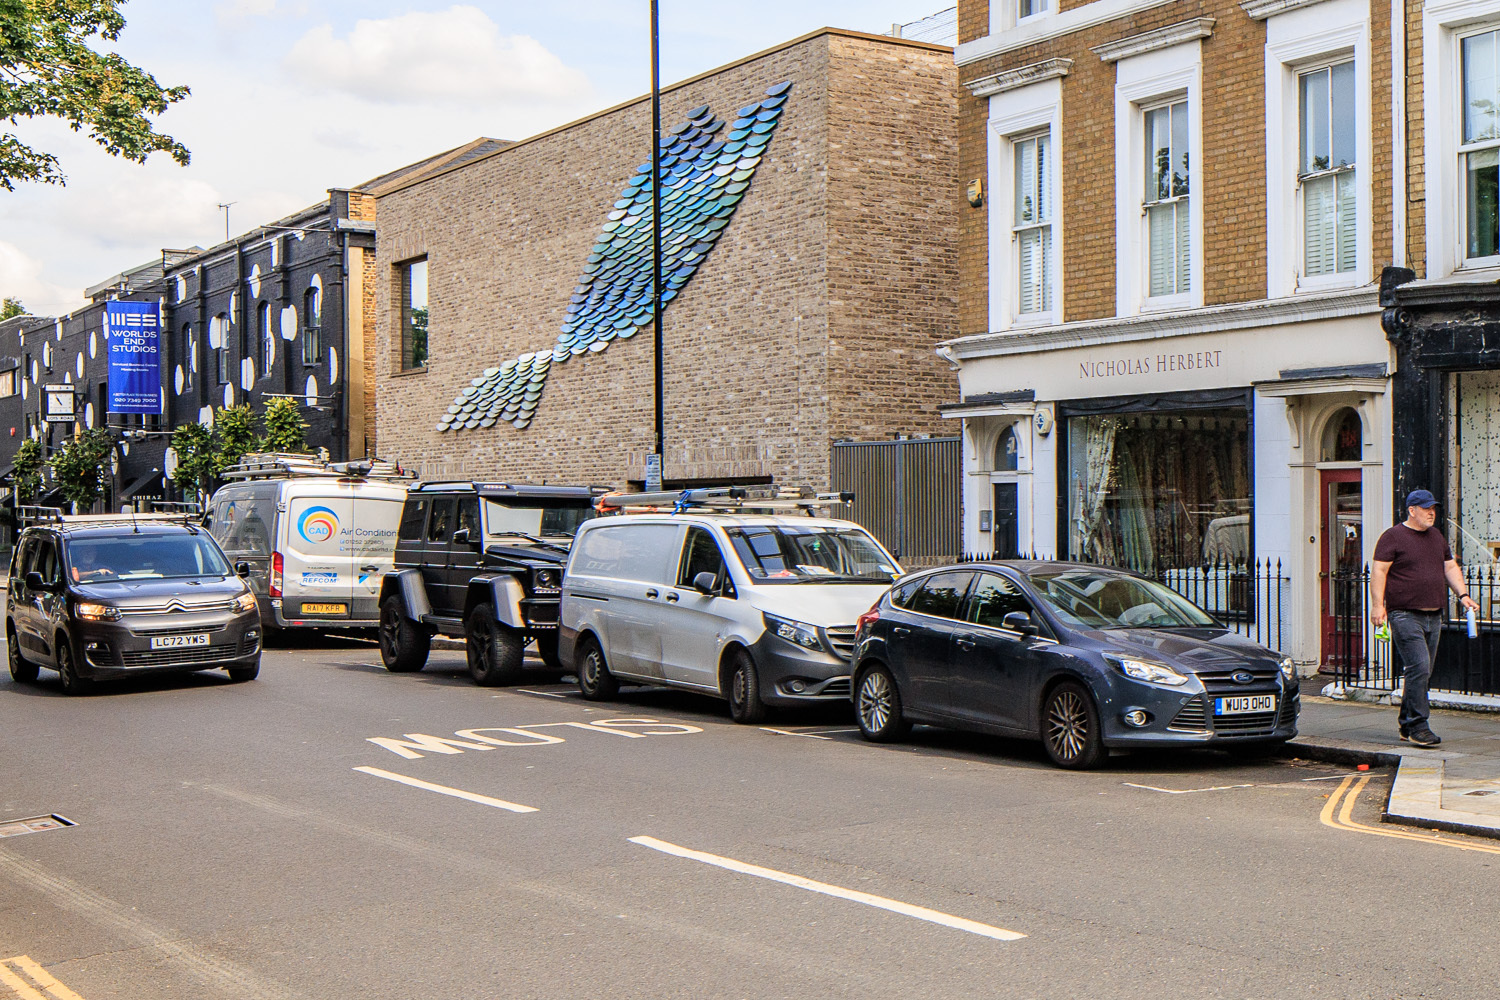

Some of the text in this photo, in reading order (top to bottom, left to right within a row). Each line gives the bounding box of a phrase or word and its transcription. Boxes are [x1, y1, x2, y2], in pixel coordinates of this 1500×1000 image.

[111, 330, 157, 339] WORLDS
[123, 338, 146, 346] END
[111, 345, 157, 354] STUDIOS
[1079, 350, 1222, 379] NICHOLAS HERBERT
[308, 527, 329, 535] CAD
[340, 528, 353, 536] Air
[155, 637, 184, 647] LC72
[1225, 698, 1250, 711] WU13
[365, 718, 704, 760] SLOW
